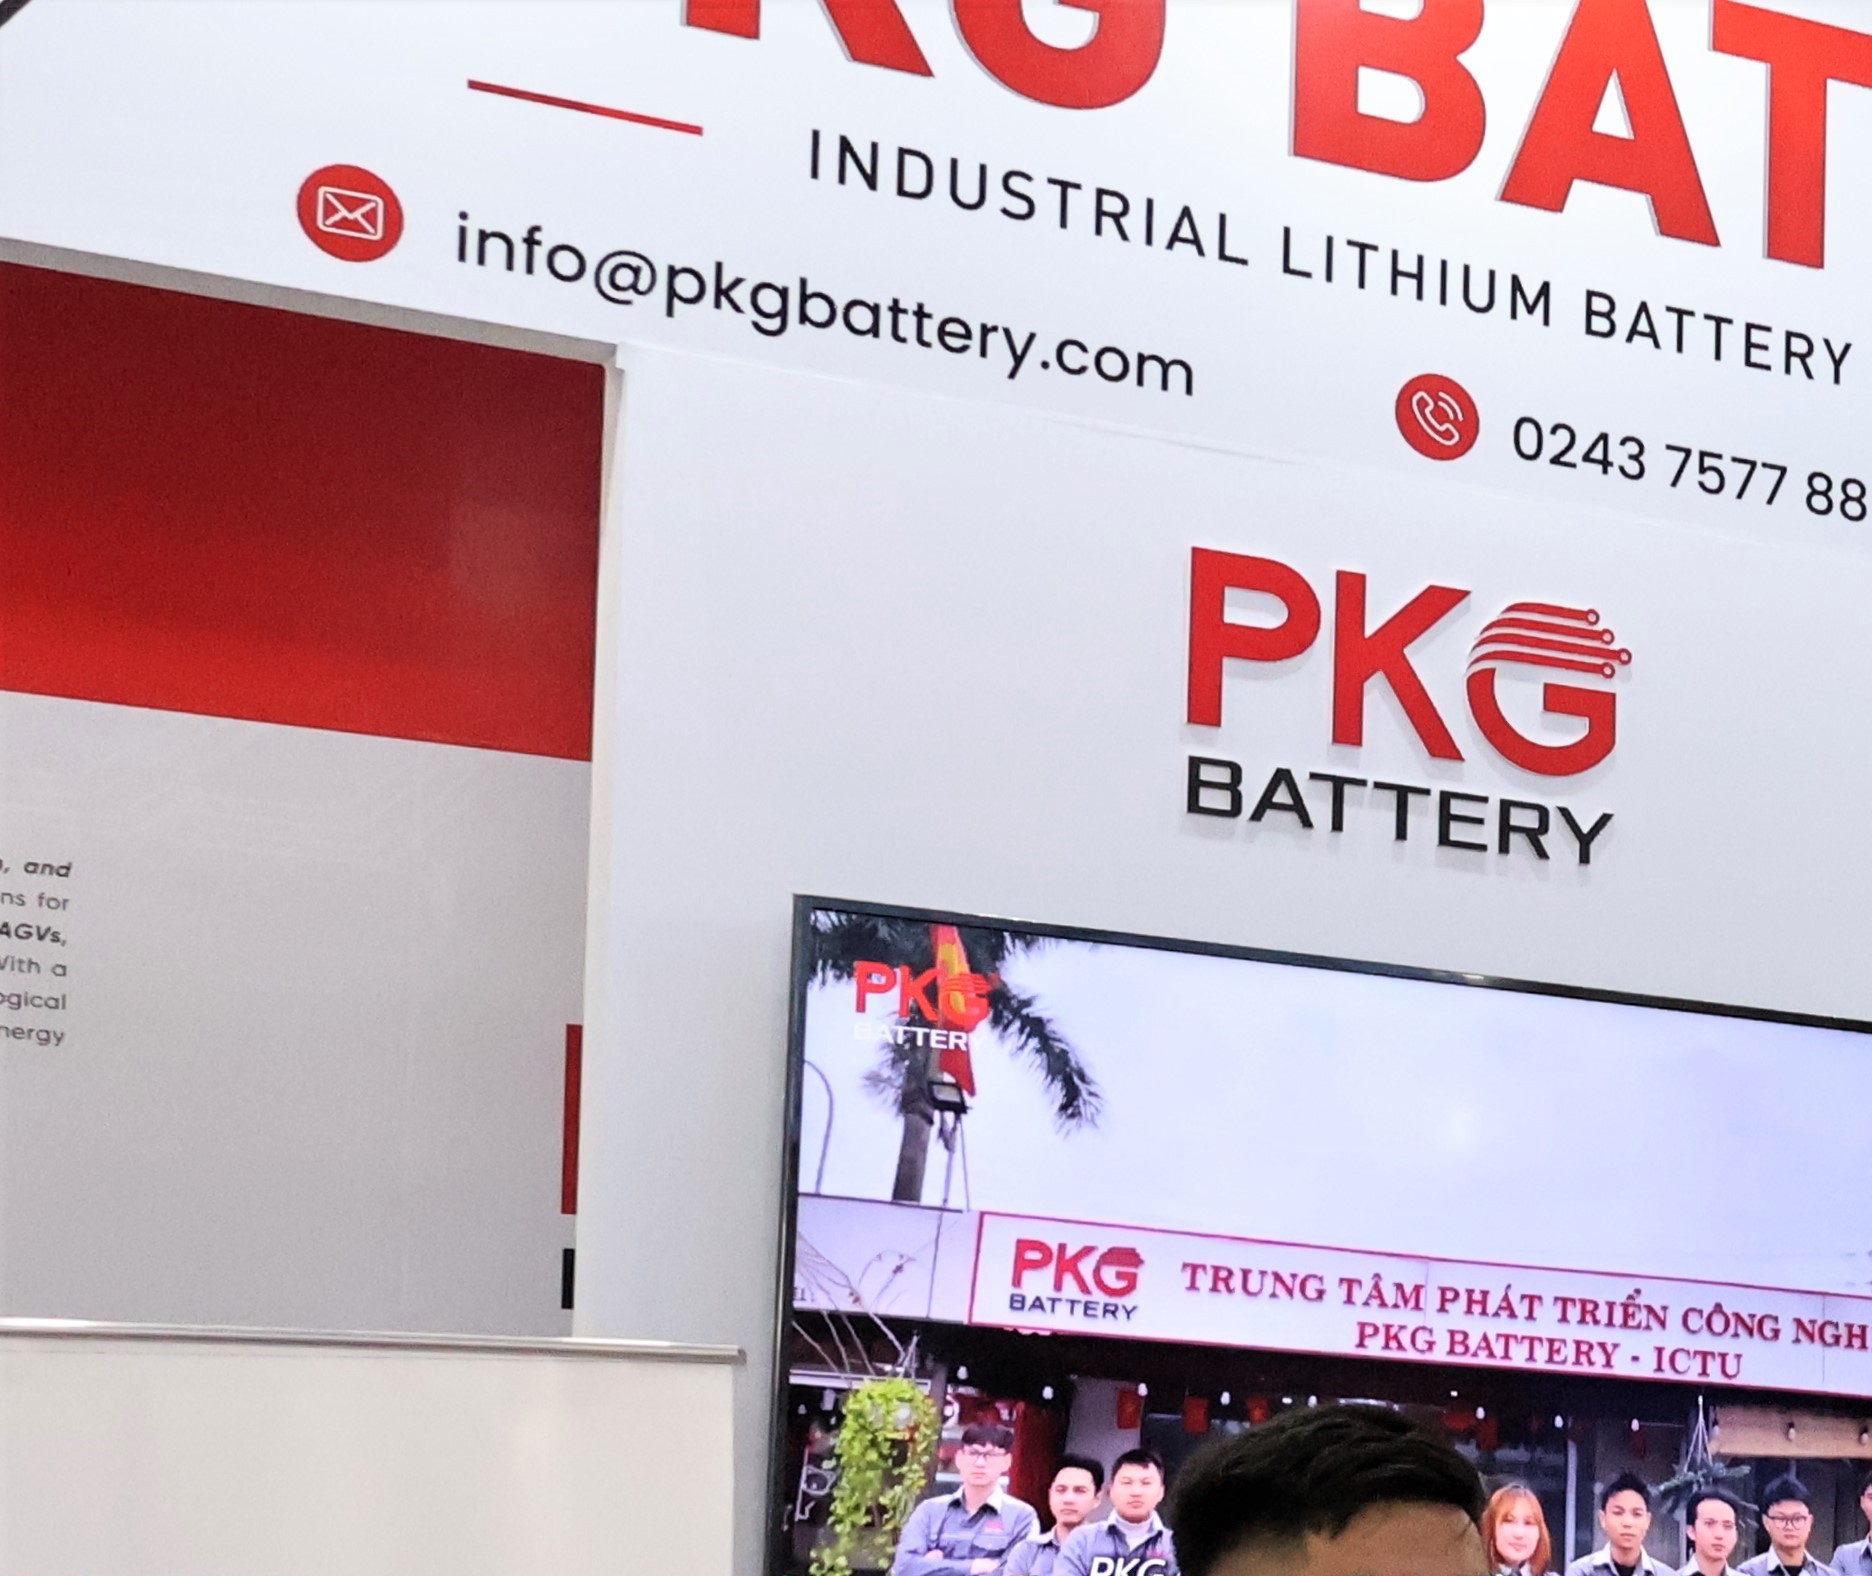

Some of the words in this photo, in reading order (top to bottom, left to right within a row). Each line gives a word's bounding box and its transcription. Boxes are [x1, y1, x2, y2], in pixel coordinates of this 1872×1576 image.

[811, 129, 1248, 266] INDUSTRIAL
[1282, 226, 1550, 327] LITHIUM
[1585, 289, 1852, 385] BATTERY
[458, 198, 1193, 396] info@pkgbattery.com
[1513, 416, 1645, 481] 0243
[1665, 444, 1787, 505] 7577
[1187, 547, 1632, 777] PKG
[1187, 756, 1613, 865] BATTERY
[24, 862, 72, 878] and
[855, 961, 993, 1027] PKG
[1009, 1294, 1137, 1320] BATTERY
[1012, 1239, 1144, 1297] PKG
[1181, 1262, 1326, 1302] TRUNG
[1339, 1272, 1425, 1311] TÂM
[1436, 1284, 1543, 1321] PHÁT
[1553, 1289, 1668, 1331] TRIỂN
[1682, 1302, 1781, 1341] CÔNG
[1355, 1321, 1436, 1355] PKG
[1446, 1330, 1620, 1369] BATTERY
[1653, 1346, 1743, 1380] ICTU
